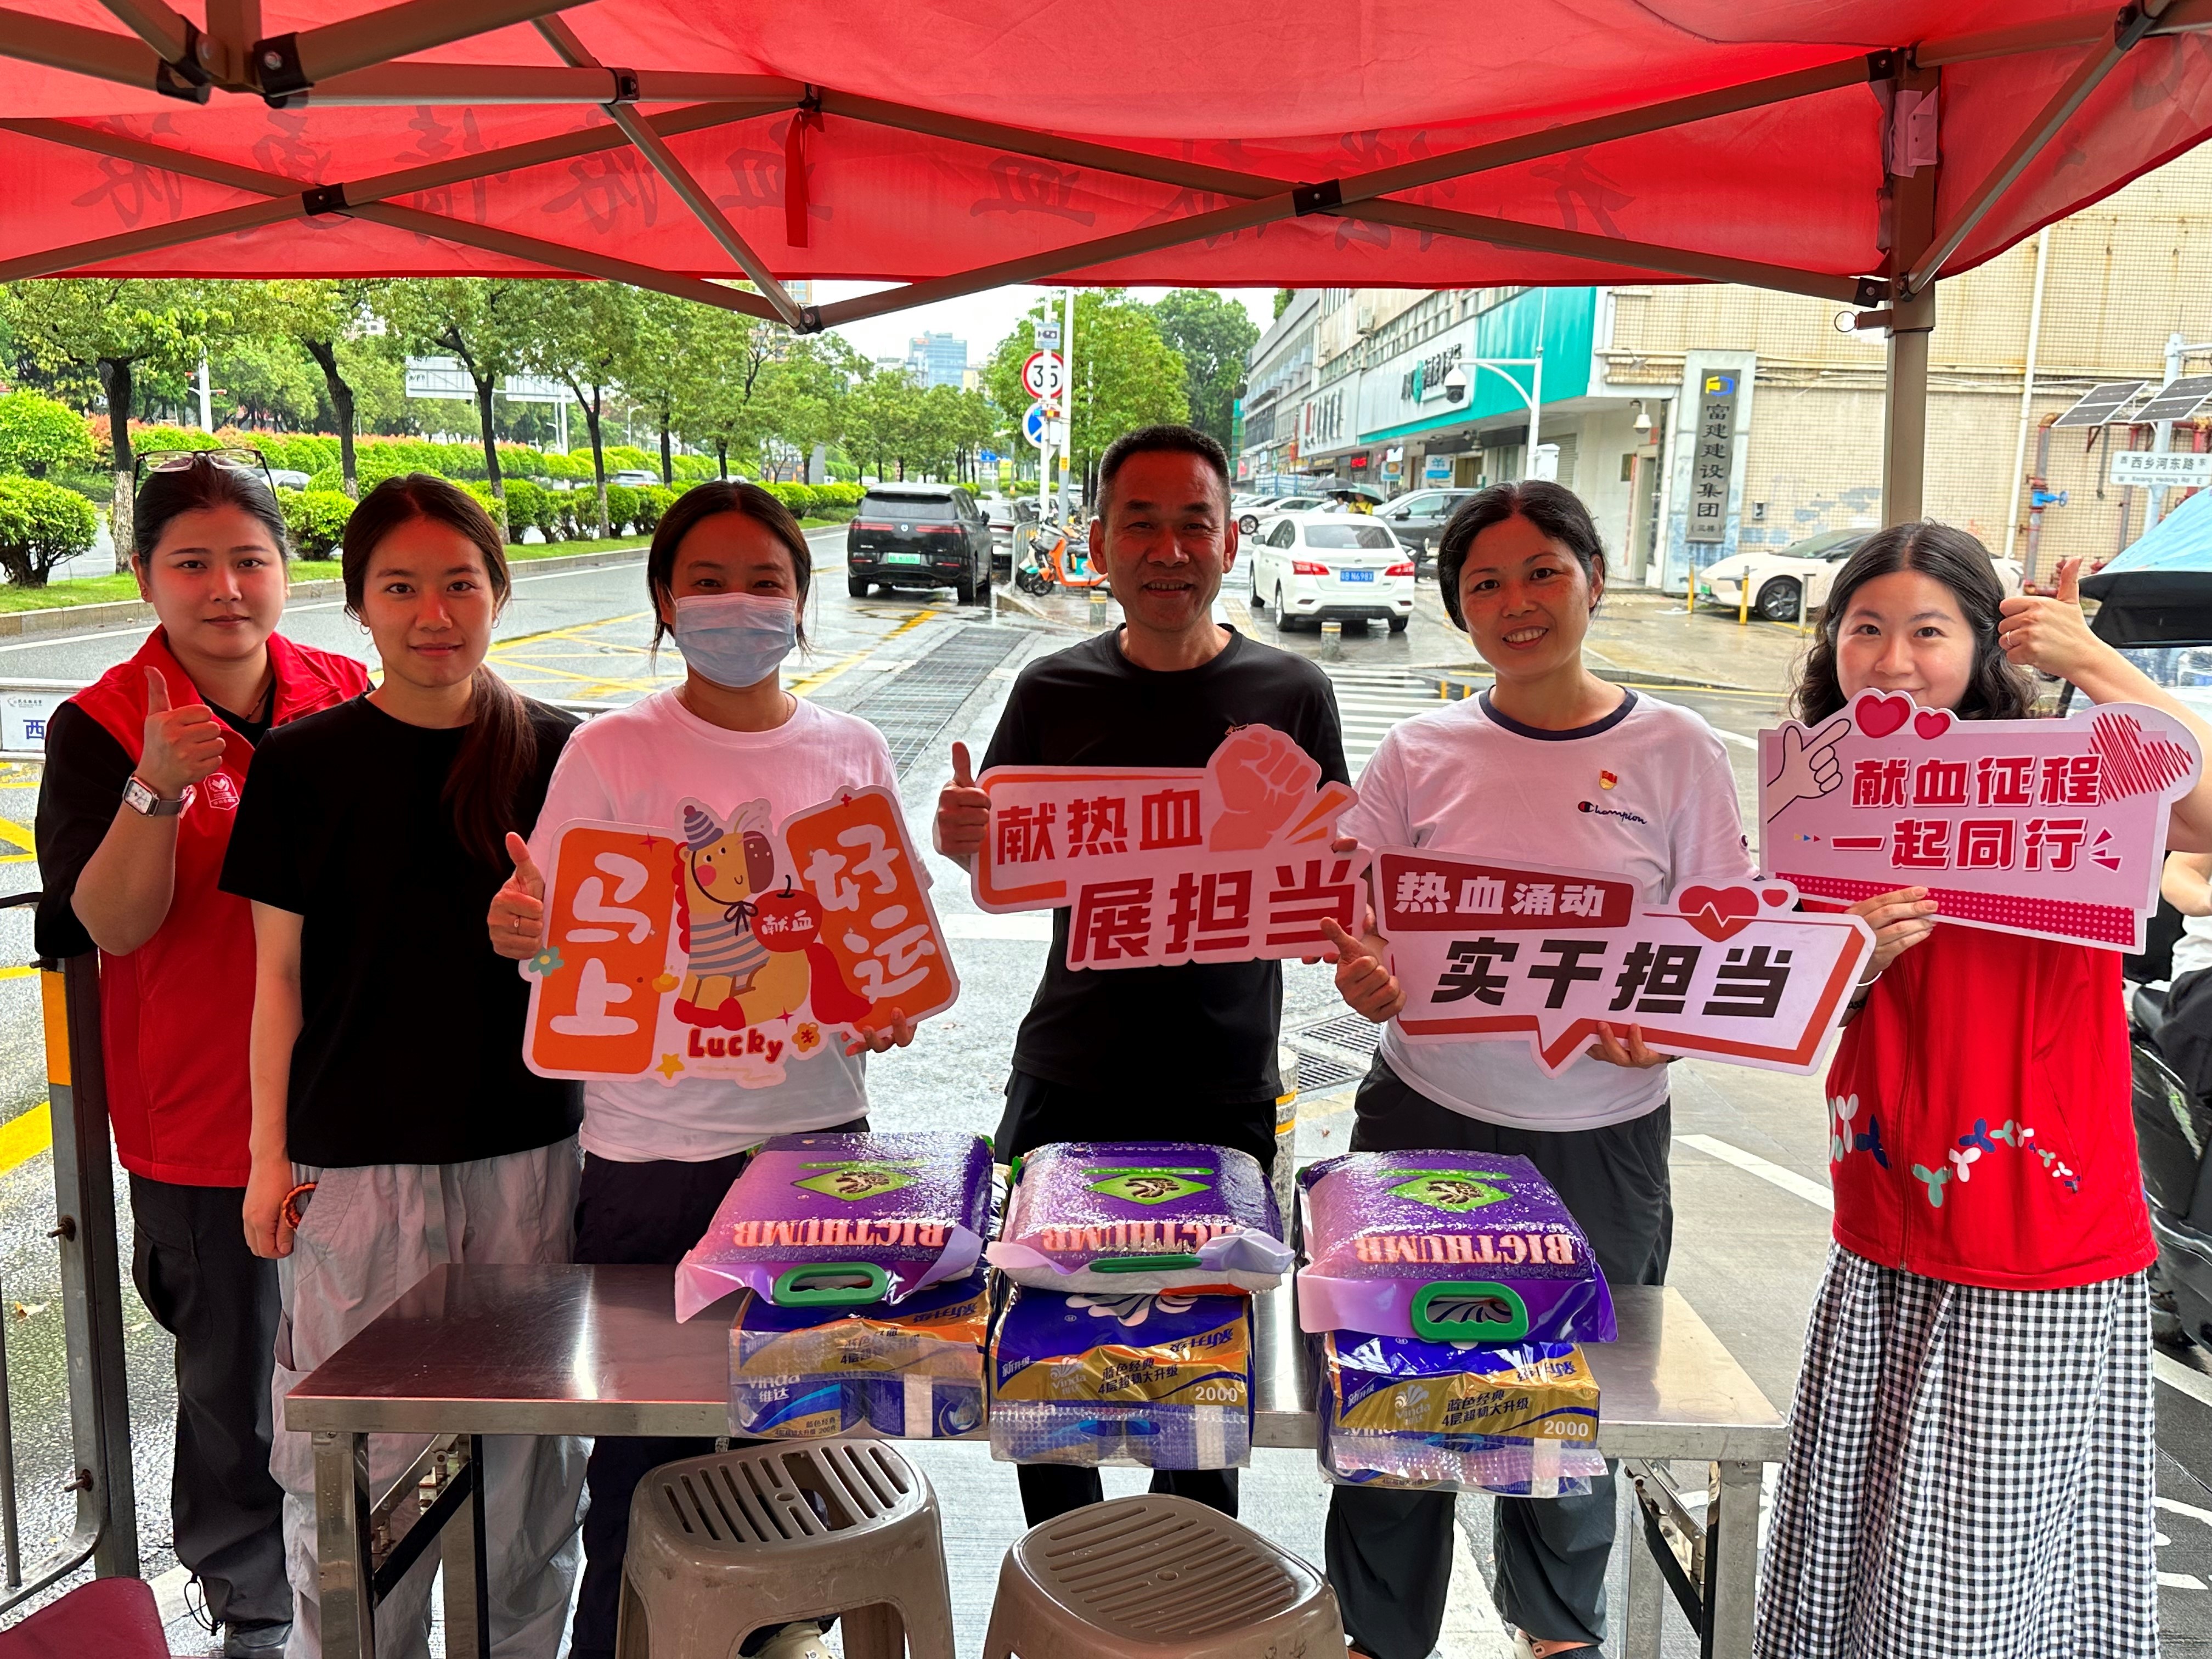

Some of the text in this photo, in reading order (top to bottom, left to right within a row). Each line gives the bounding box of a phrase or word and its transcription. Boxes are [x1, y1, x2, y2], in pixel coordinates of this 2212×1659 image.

[1696, 404, 1729, 517] 富建建设集团
[2131, 456, 2194, 470] 西乡河东路
[23, 719, 46, 740] 西
[1852, 755, 2103, 808] 献血征程
[997, 788, 1202, 865] 献热血
[1578, 801, 1647, 824] Champion
[1831, 817, 2086, 872] 一起同行
[1393, 871, 1606, 917] 热血涌动
[761, 910, 814, 935] 献血
[804, 823, 936, 1004] 好运
[1071, 860, 1353, 963] 展担当
[549, 851, 654, 1036] 马上
[1430, 937, 1793, 1018] 实干担当
[688, 1027, 783, 1064] Lucky
[1041, 1221, 1238, 1252] GTHUMB
[1355, 1233, 1575, 1264] BIGTHUMB
[1170, 1328, 1233, 1353] 新升级
[1098, 1364, 1178, 1394] 4层超韧大升级
[1102, 1357, 1155, 1381] 蓝色经典
[759, 1387, 789, 1402] 维达
[1195, 1386, 1238, 1402] 2000
[1447, 1389, 1505, 1412] 蓝色经典
[1442, 1397, 1530, 1426] 4层超韧大升级
[1544, 1420, 1589, 1437] 2000
